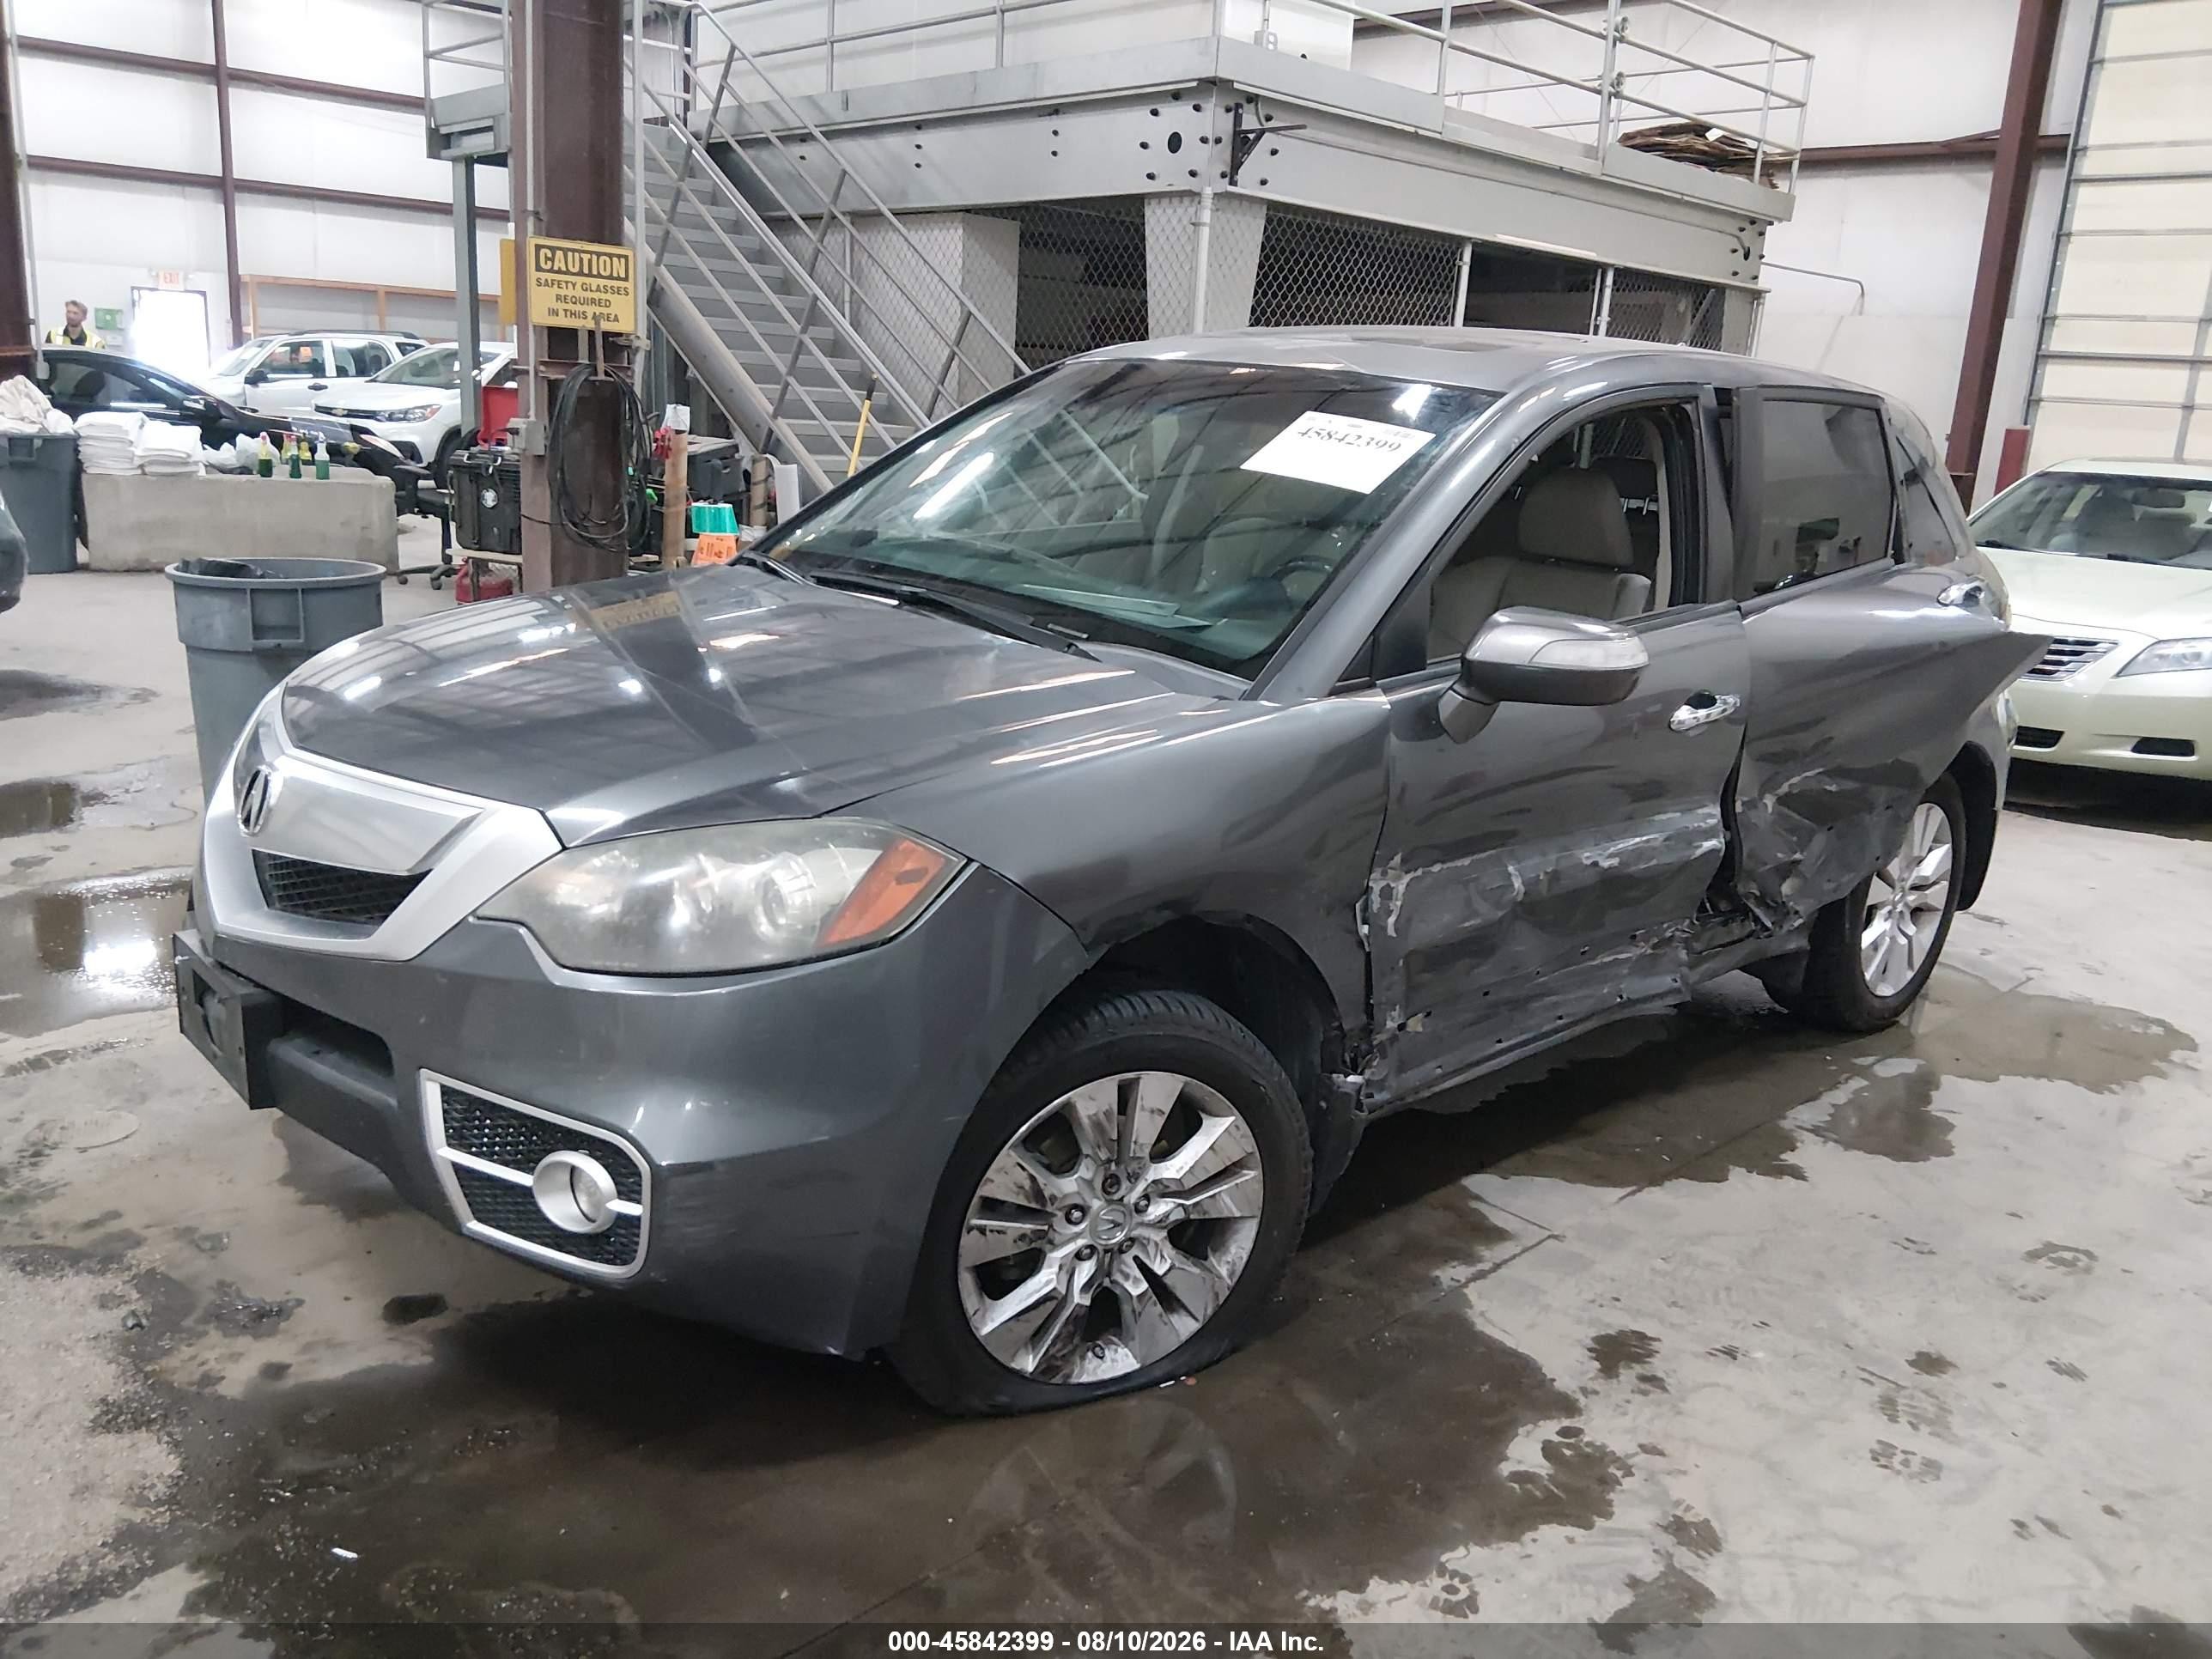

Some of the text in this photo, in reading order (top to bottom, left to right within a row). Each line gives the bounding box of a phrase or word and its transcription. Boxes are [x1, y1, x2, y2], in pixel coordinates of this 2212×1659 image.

[539, 248, 626, 277] CAUTION
[535, 277, 629, 296] SAFETY GLASSES
[556, 294, 611, 308] REQUIRED
[548, 307, 559, 317] IN
[562, 309, 588, 319] THIS
[1297, 427, 1401, 452] 45842399
